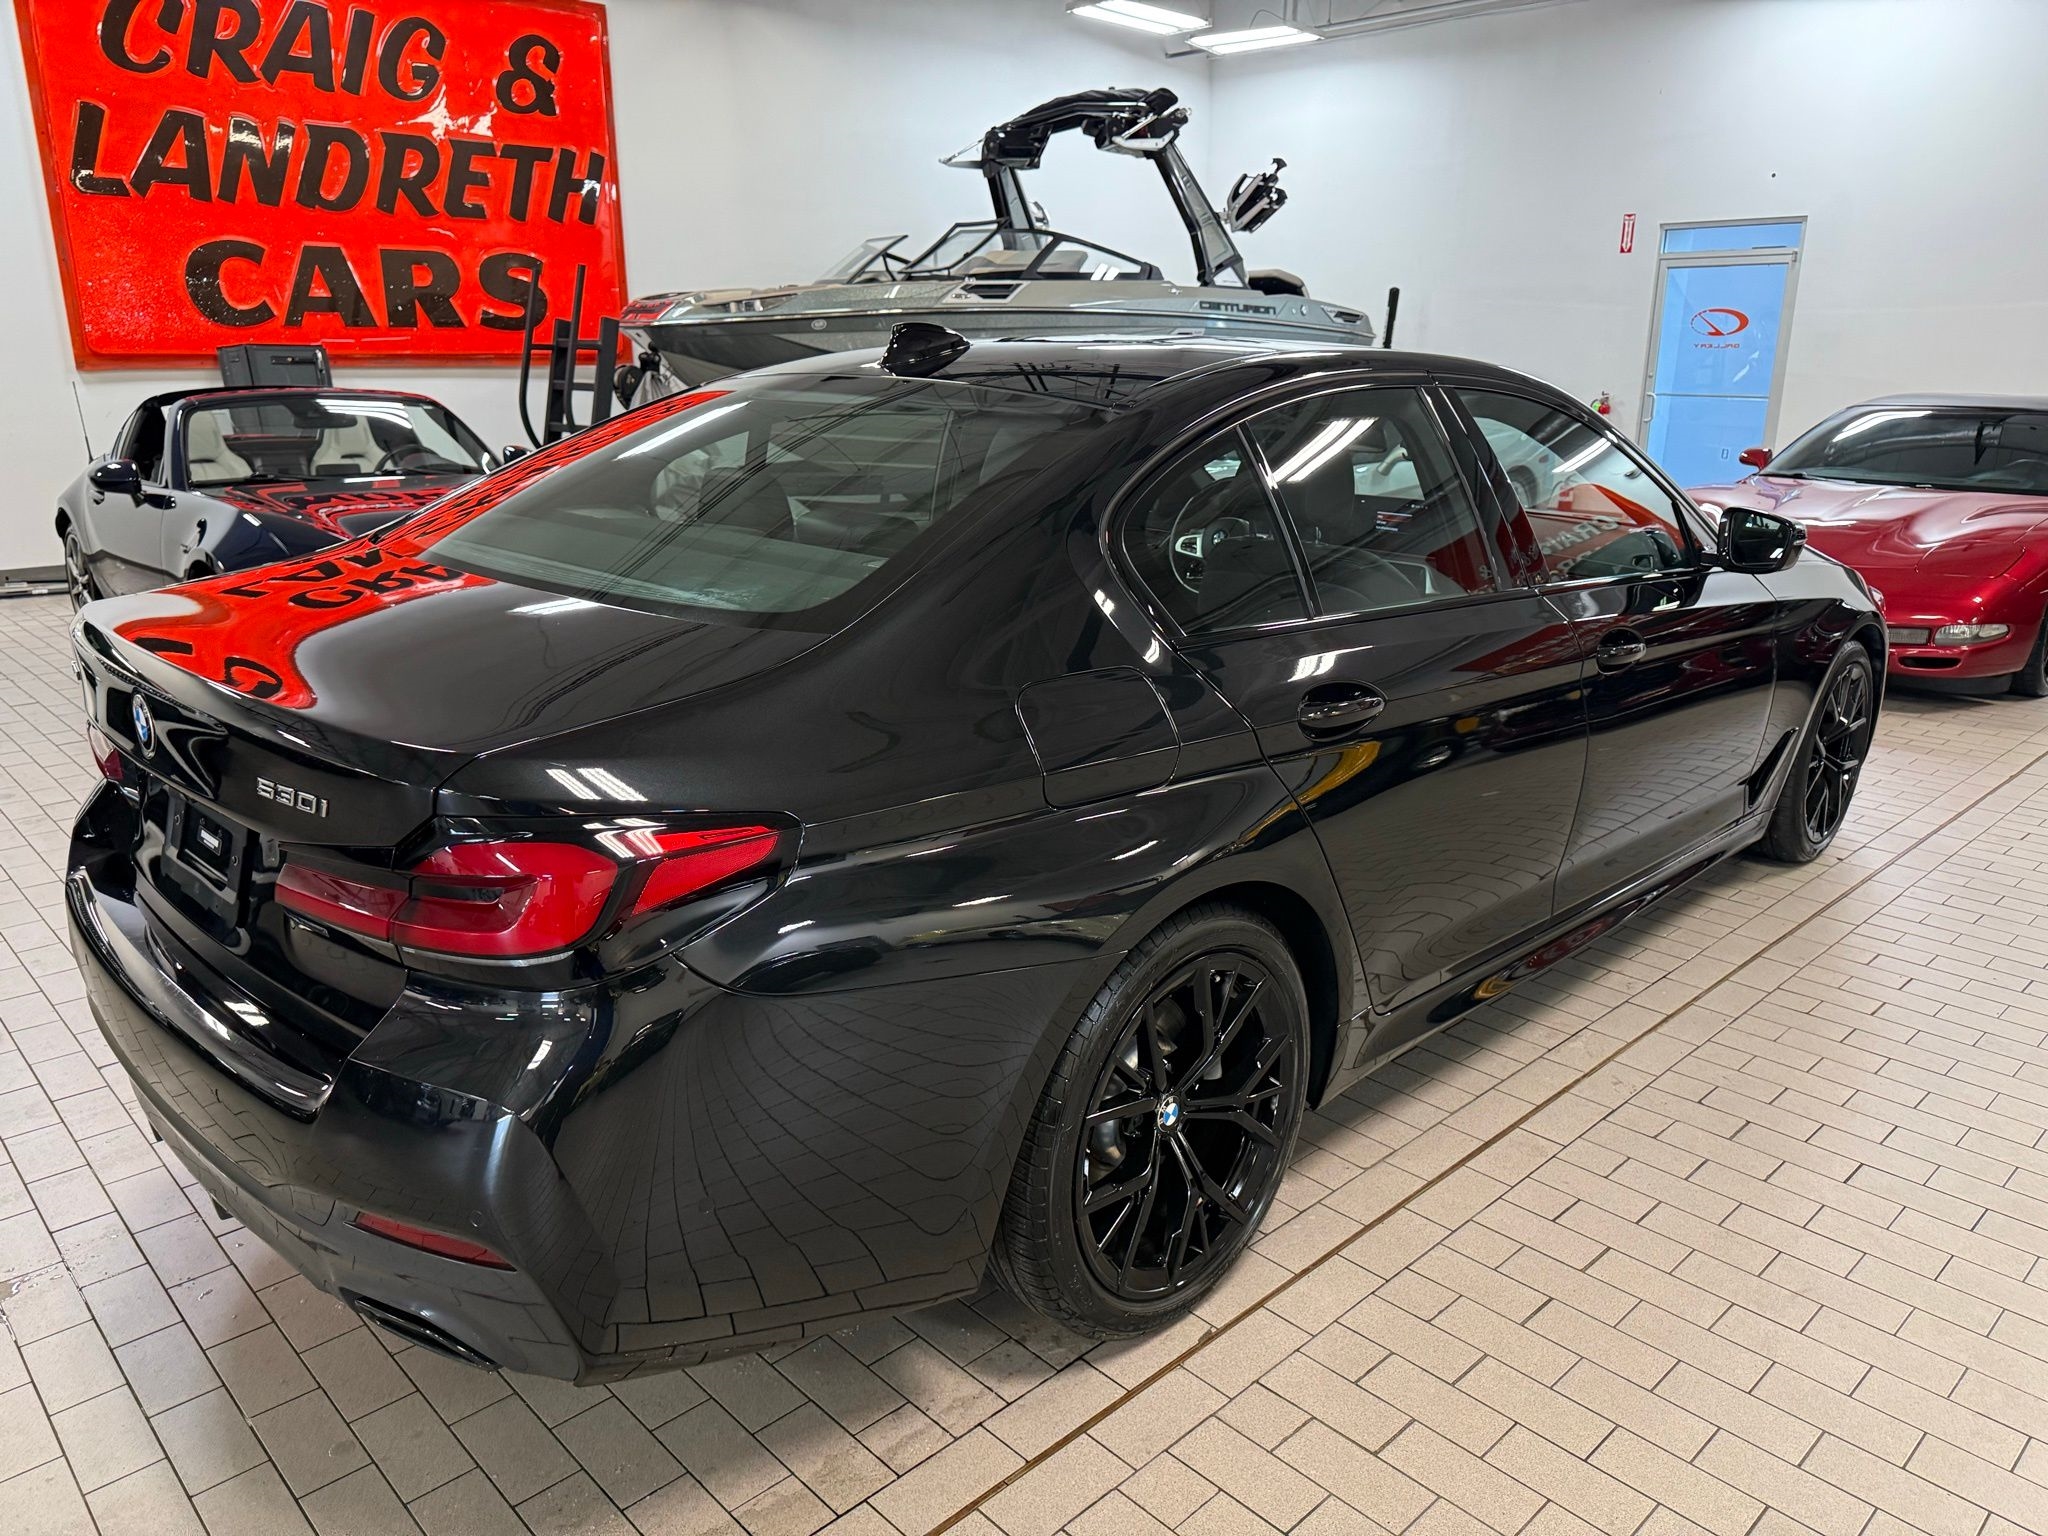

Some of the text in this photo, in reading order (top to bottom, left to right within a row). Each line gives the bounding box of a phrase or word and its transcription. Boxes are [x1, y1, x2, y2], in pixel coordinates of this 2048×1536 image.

[100, 0, 561, 117] CRAIG &
[72, 100, 605, 225] LANDRETH
[184, 240, 548, 331] CARS
